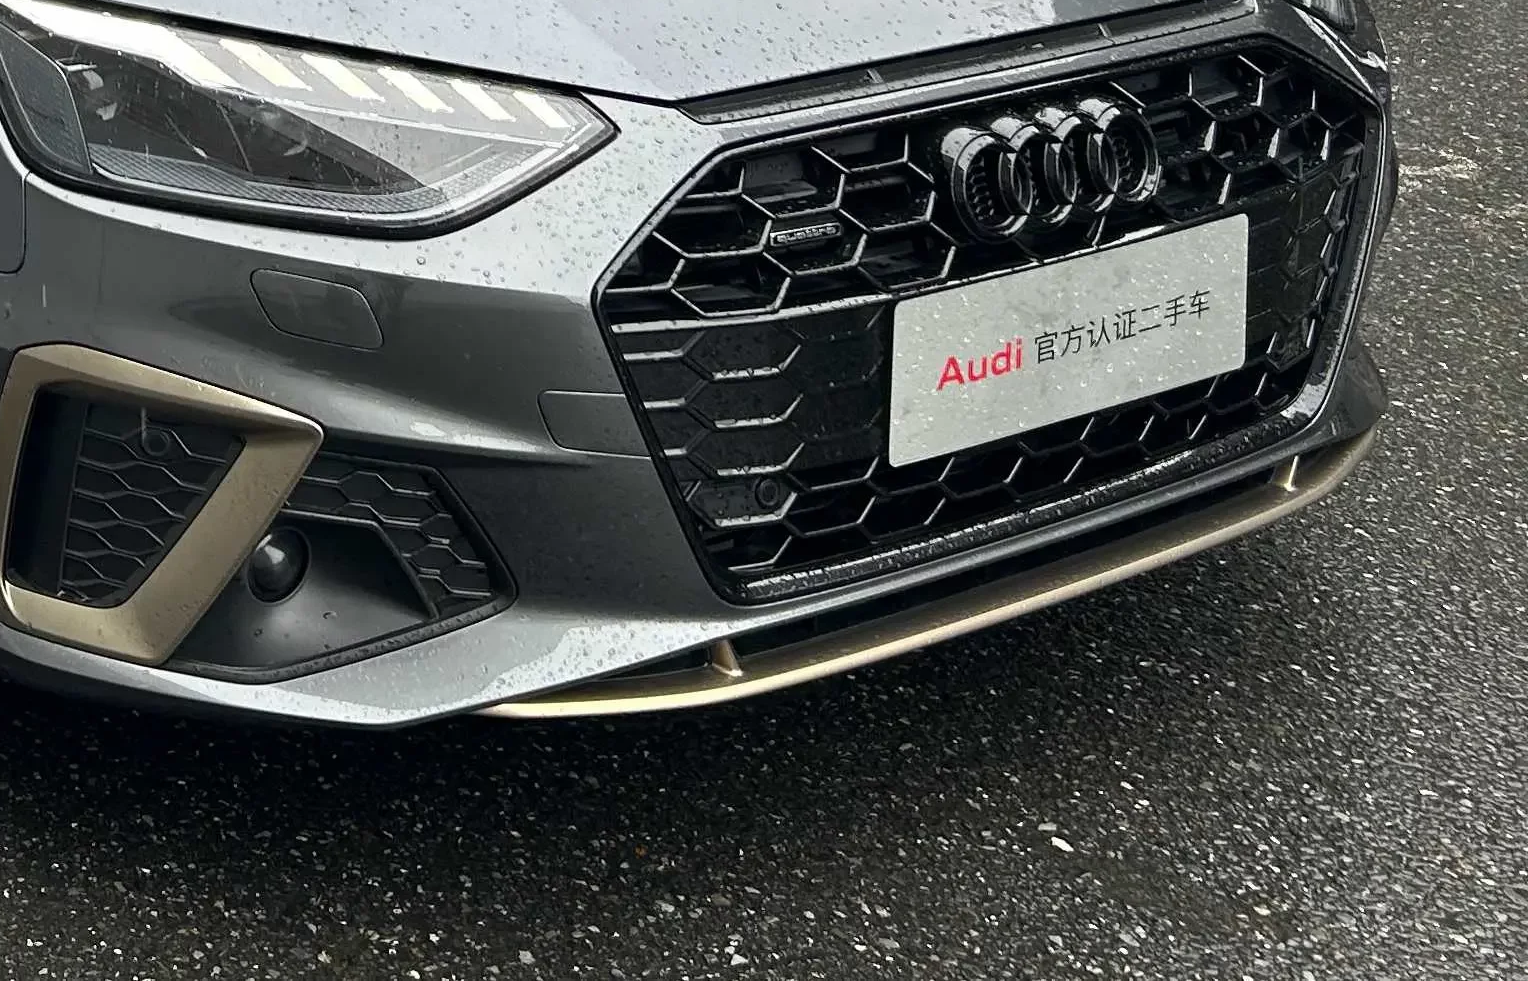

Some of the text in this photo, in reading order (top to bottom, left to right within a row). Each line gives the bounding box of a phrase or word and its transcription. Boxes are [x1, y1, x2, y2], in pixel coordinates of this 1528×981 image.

[936, 290, 1210, 391] Audi 官方认证二手车
